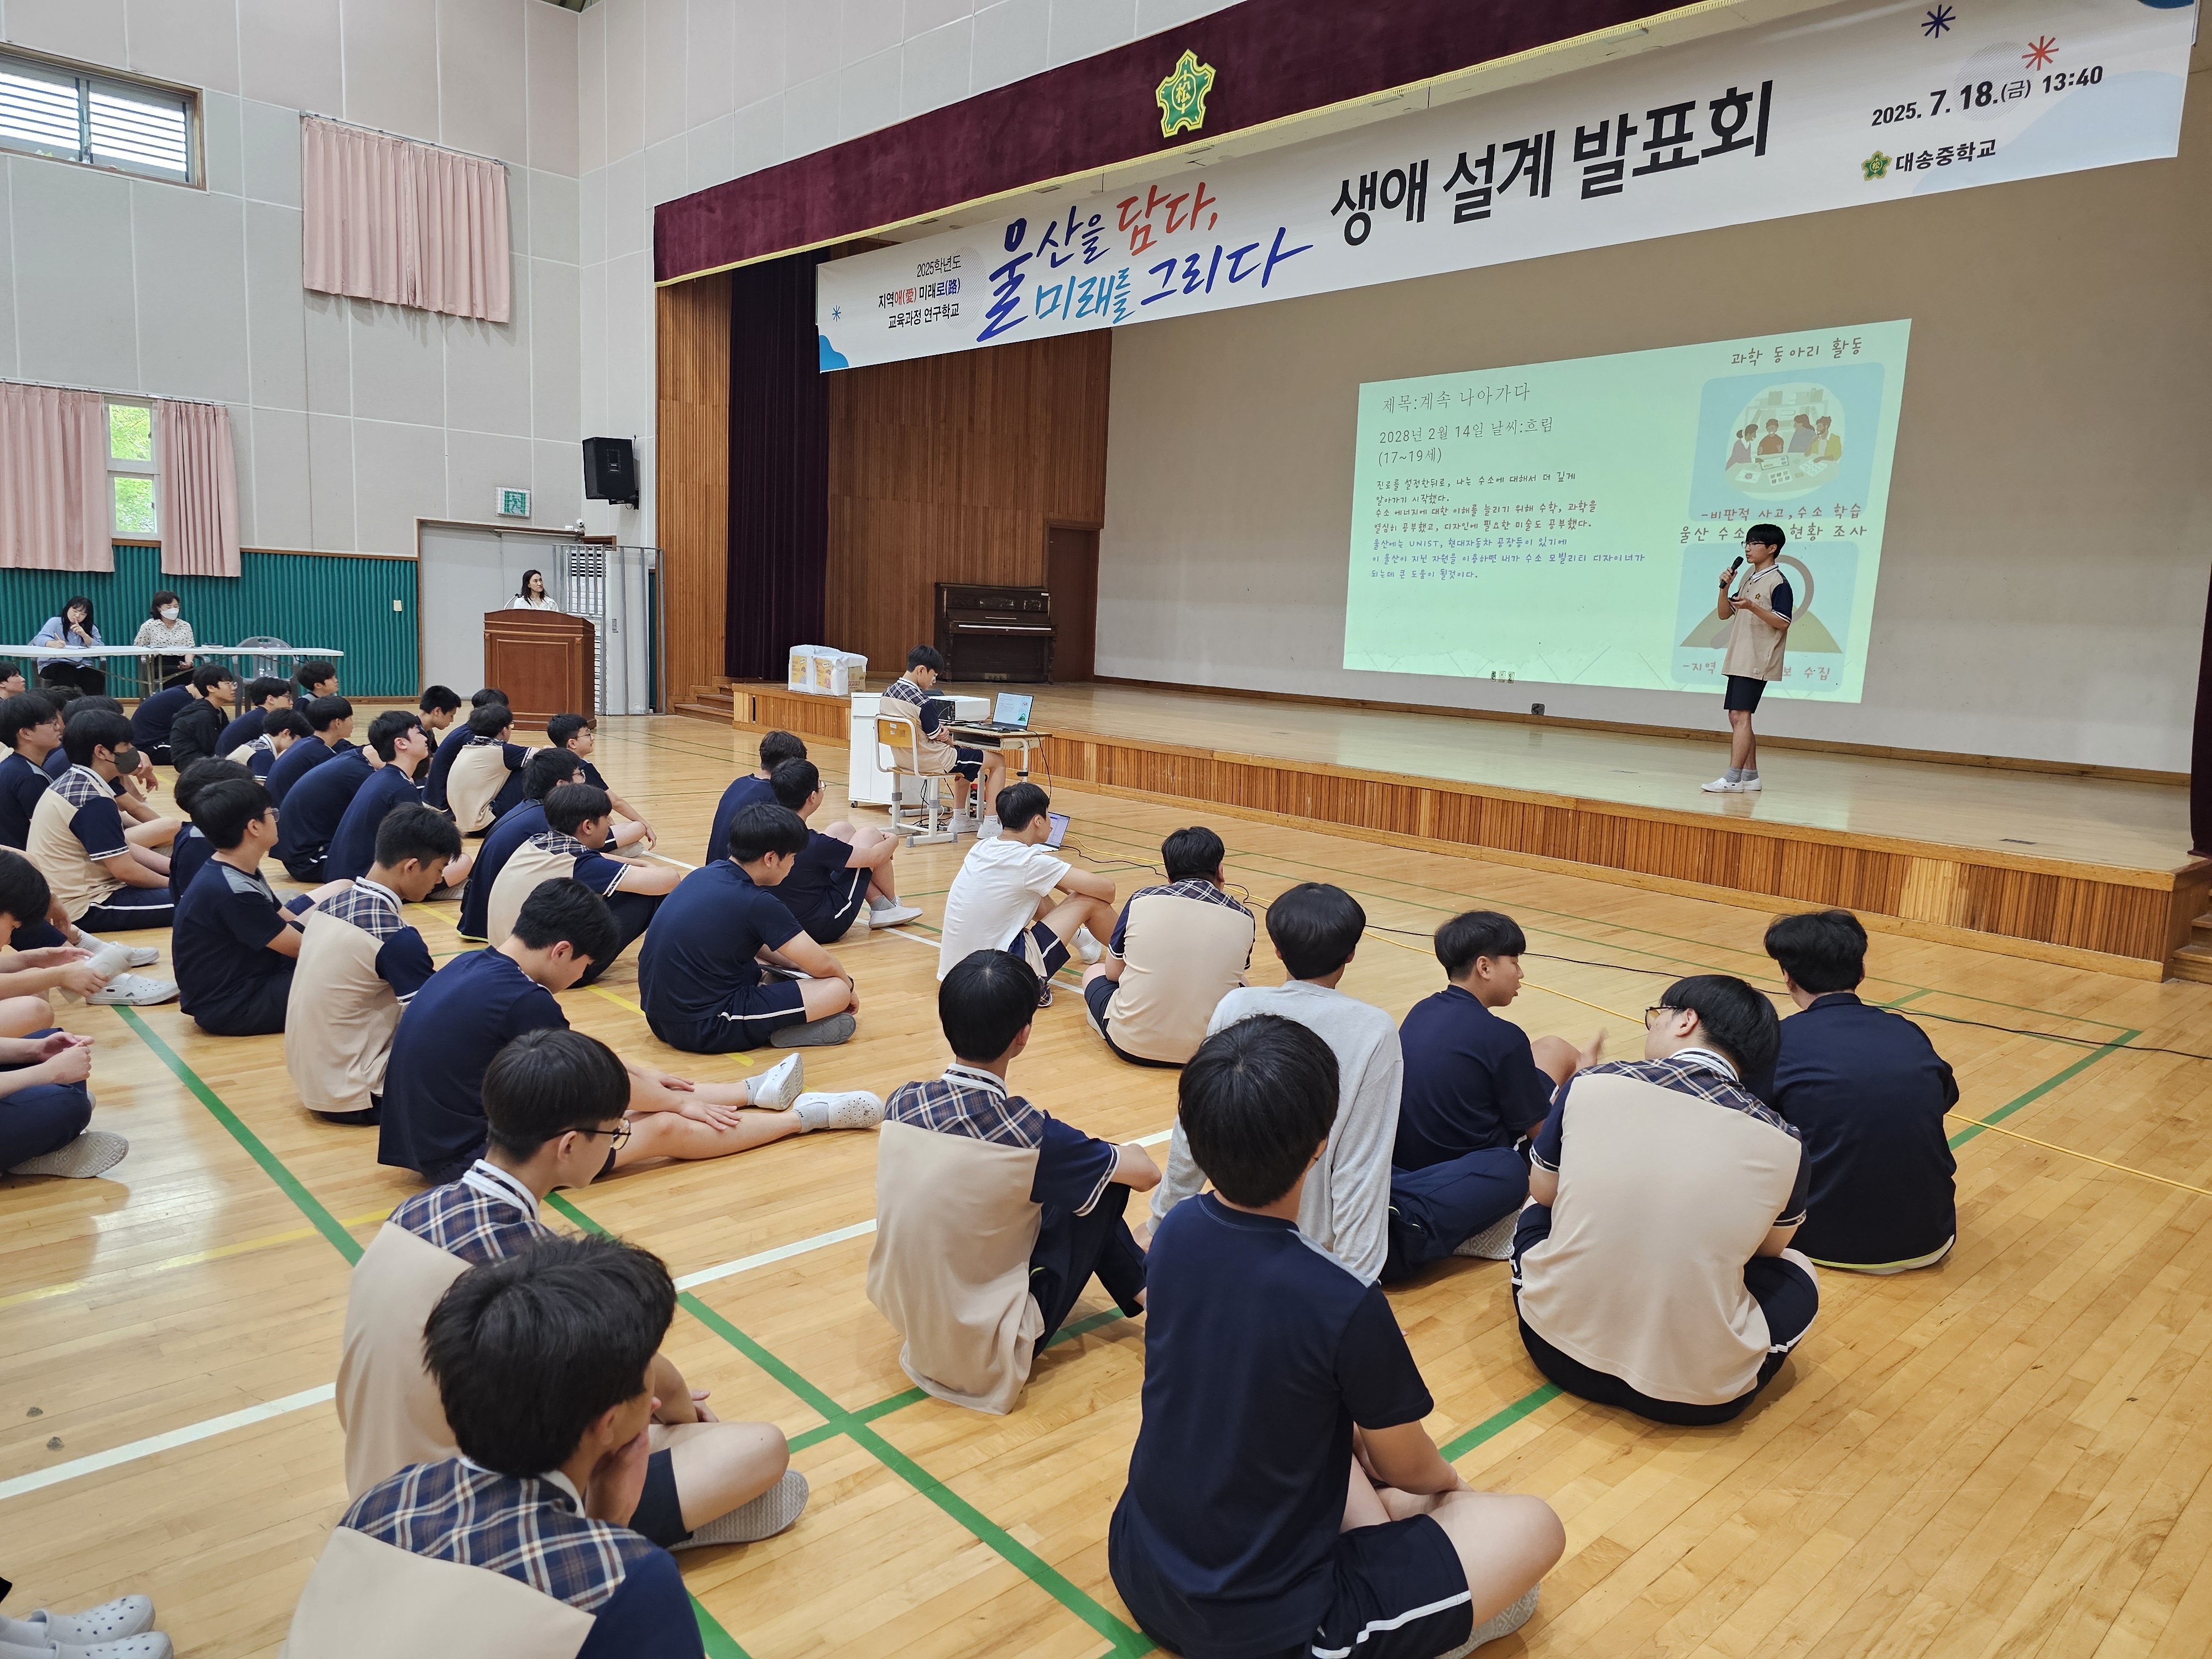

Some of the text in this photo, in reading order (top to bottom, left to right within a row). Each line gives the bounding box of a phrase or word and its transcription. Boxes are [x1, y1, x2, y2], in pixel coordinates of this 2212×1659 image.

[1871, 102, 1922, 127] 2025.
[1930, 90, 1950, 116] 7.
[2042, 66, 2103, 93] 13:40
[1330, 80, 1773, 246] 생애 설계 발표회
[1895, 139, 1996, 172] 대송중학교
[917, 255, 961, 277] 2025학년도
[976, 182, 1218, 342] 울산을 담다,
[1035, 227, 1313, 324] 미래를 그리다
[879, 278, 961, 309] 지역애(愛) 미래로(路)
[889, 303, 959, 328] 교육과정 연구학교
[1731, 337, 1862, 366] 과학 동아리 활동
[1383, 383, 1530, 414] 제목:계속 나아가다
[1380, 416, 1553, 443] 2028년 2월 14일 날씨:흐림
[1379, 447, 1442, 467] (17~19세)
[1377, 479, 1400, 491] 진로를
[1405, 478, 1451, 490] 설정한뒤로,
[1457, 477, 1471, 486] 나는
[1479, 476, 1504, 485] 수소에
[1557, 471, 1575, 482] 깊게
[1376, 493, 1449, 506] 알아가기 시작했다.
[1376, 509, 1389, 518] 수소
[1432, 506, 1449, 515] 대한
[1453, 504, 1478, 517] 이해를
[1484, 504, 1509, 516] 늘리기
[1515, 504, 1533, 513] 위해
[1540, 502, 1562, 514] 수학,
[1568, 500, 1597, 513] 과학을
[1701, 508, 1749, 521] -비판적
[1834, 503, 1861, 519] 학습
[1375, 518, 1591, 534] 열심히 공부했고, 디자인에 필요한 미술도 공부했다.
[1680, 526, 1709, 544] 울산
[1790, 522, 1823, 541] 현황
[1833, 525, 1867, 537] 조사
[1374, 536, 1567, 550] 울산에는 UNIST, 현대자동차 공장등이 있기에
[1384, 554, 1406, 565] 울산이
[1412, 555, 1427, 563] 지닌
[1432, 553, 1457, 564] 자원을
[1463, 554, 1496, 564] 이용하면
[1526, 554, 1542, 563] 수소
[1549, 552, 1586, 564] 모빌리티
[1371, 569, 1478, 580] 되는데 큰 도움이 될것이다.
[1804, 666, 1830, 681] 수집
